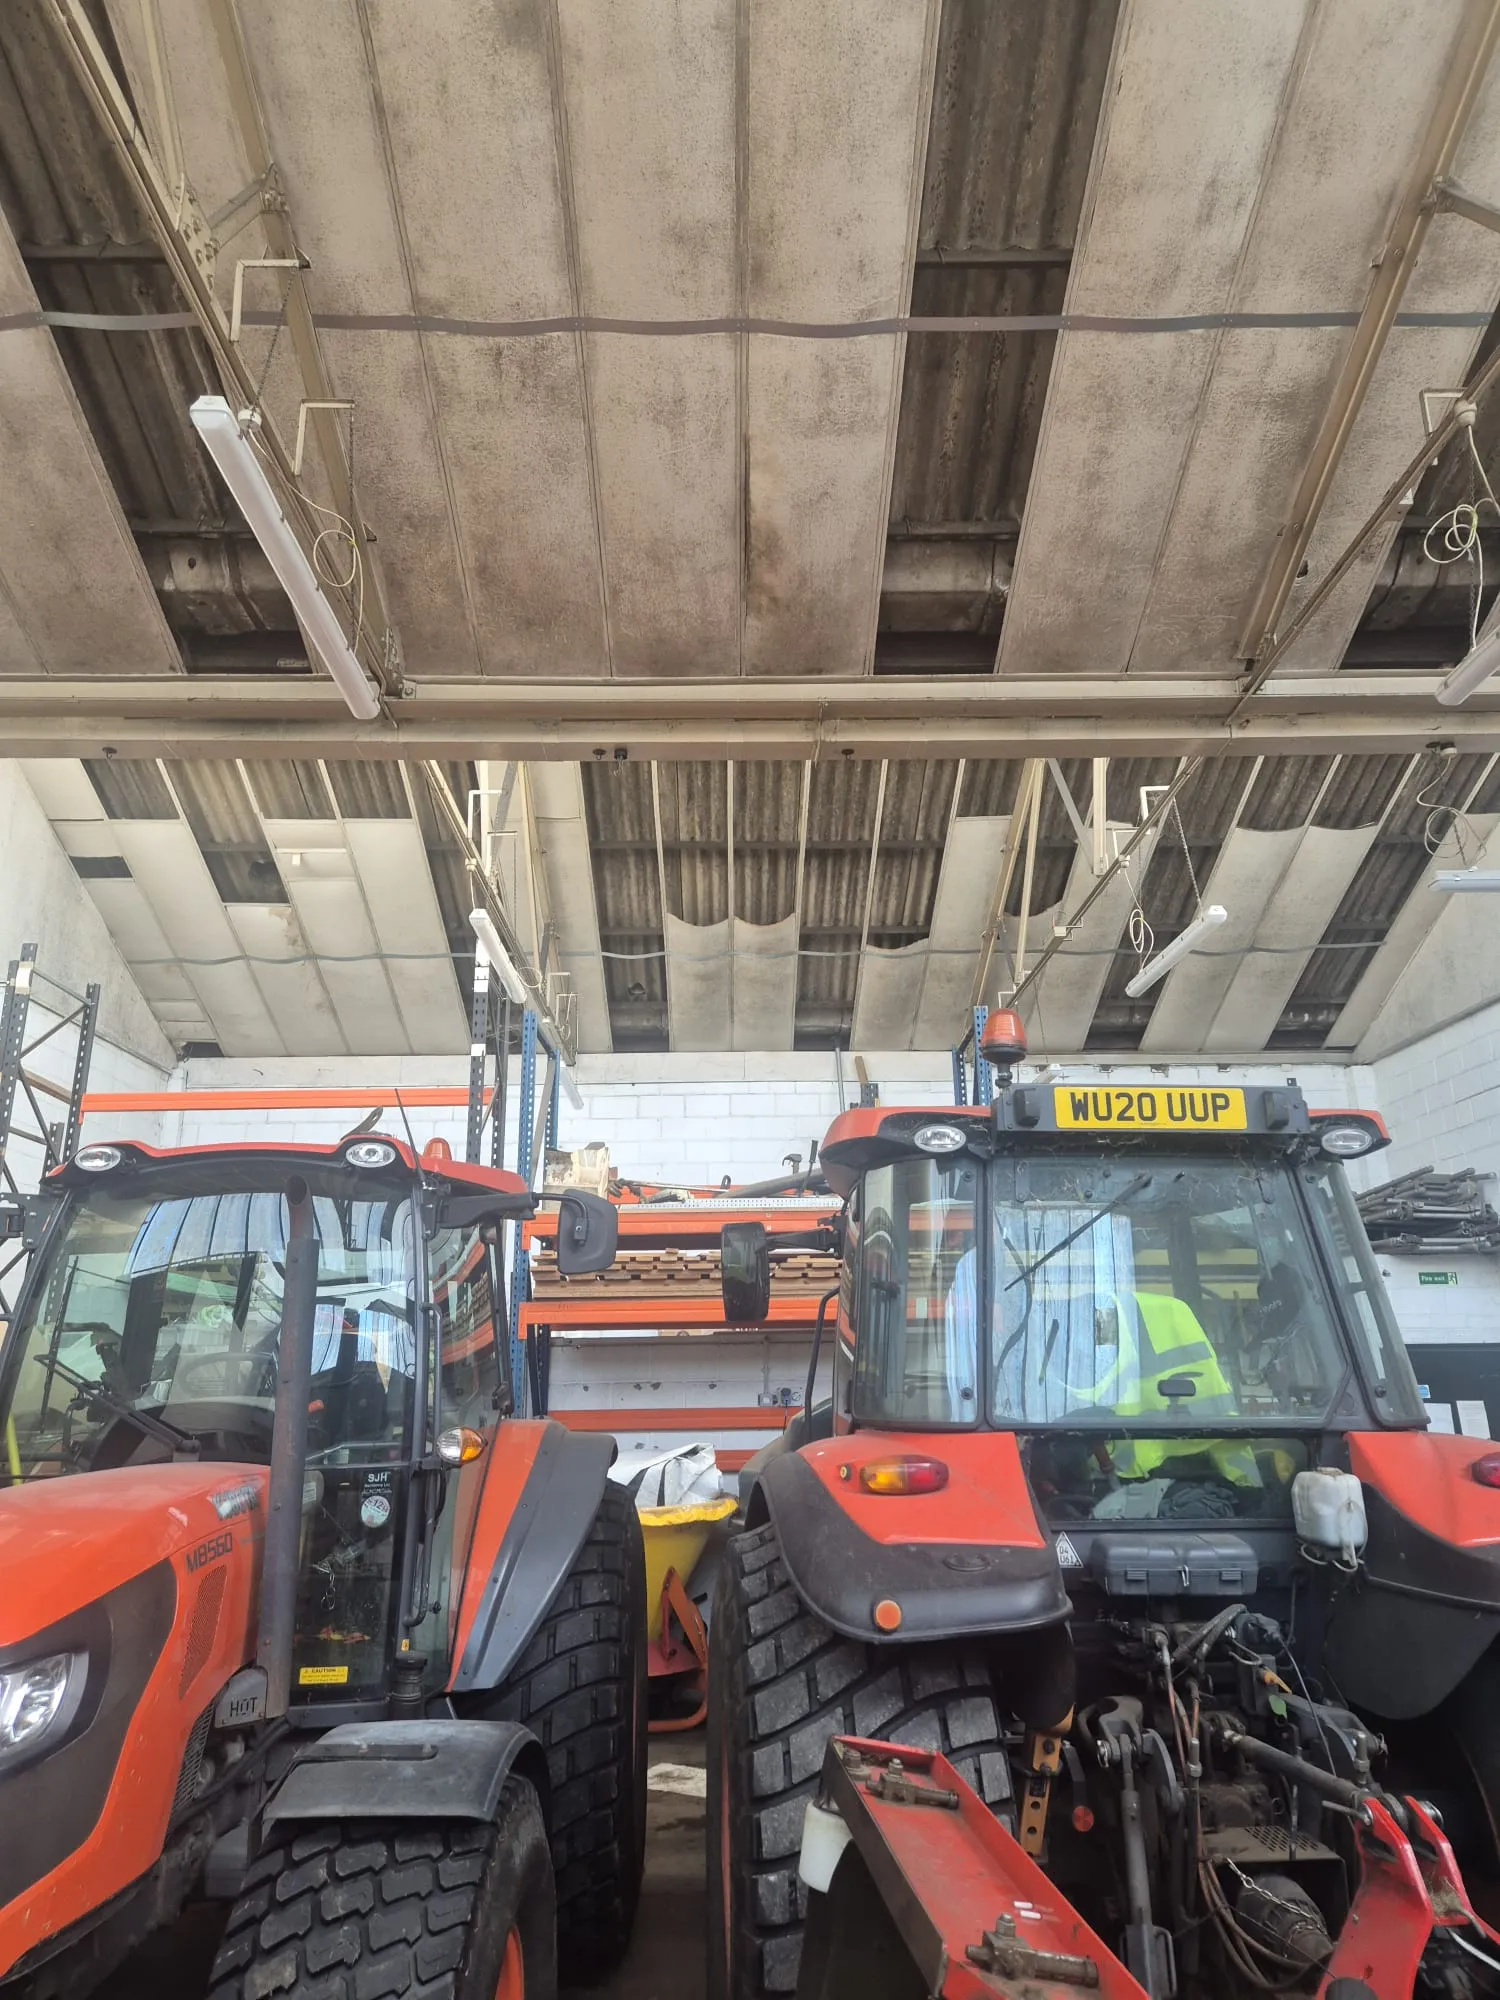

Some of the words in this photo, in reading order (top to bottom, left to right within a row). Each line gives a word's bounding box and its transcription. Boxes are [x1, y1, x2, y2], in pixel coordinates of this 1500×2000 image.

[1070, 1091, 1157, 1121] WU20
[1166, 1092, 1230, 1122] UUP
[368, 1472, 388, 1483] SJH
[230, 1697, 258, 1717] HOT
